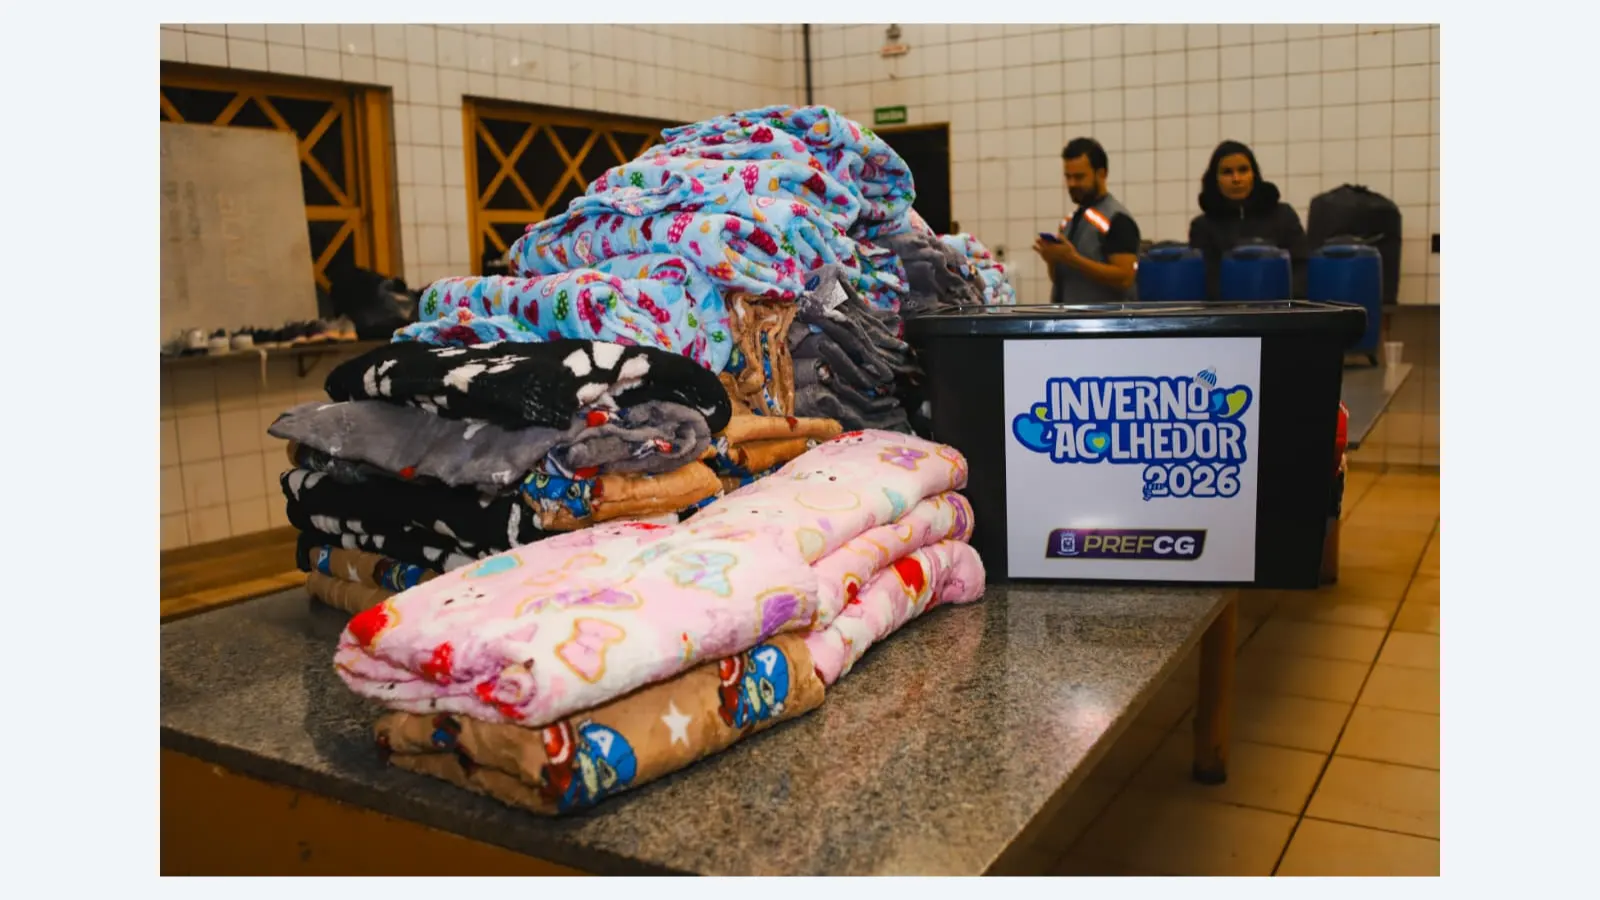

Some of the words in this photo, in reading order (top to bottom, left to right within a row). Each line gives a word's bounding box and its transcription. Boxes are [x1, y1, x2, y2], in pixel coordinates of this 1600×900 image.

[1051, 381, 1210, 420] INVERNO
[1145, 465, 1238, 496] 2026
[1083, 535, 1195, 555] PREFCG
[755, 647, 777, 676] A
[587, 729, 614, 757] A
